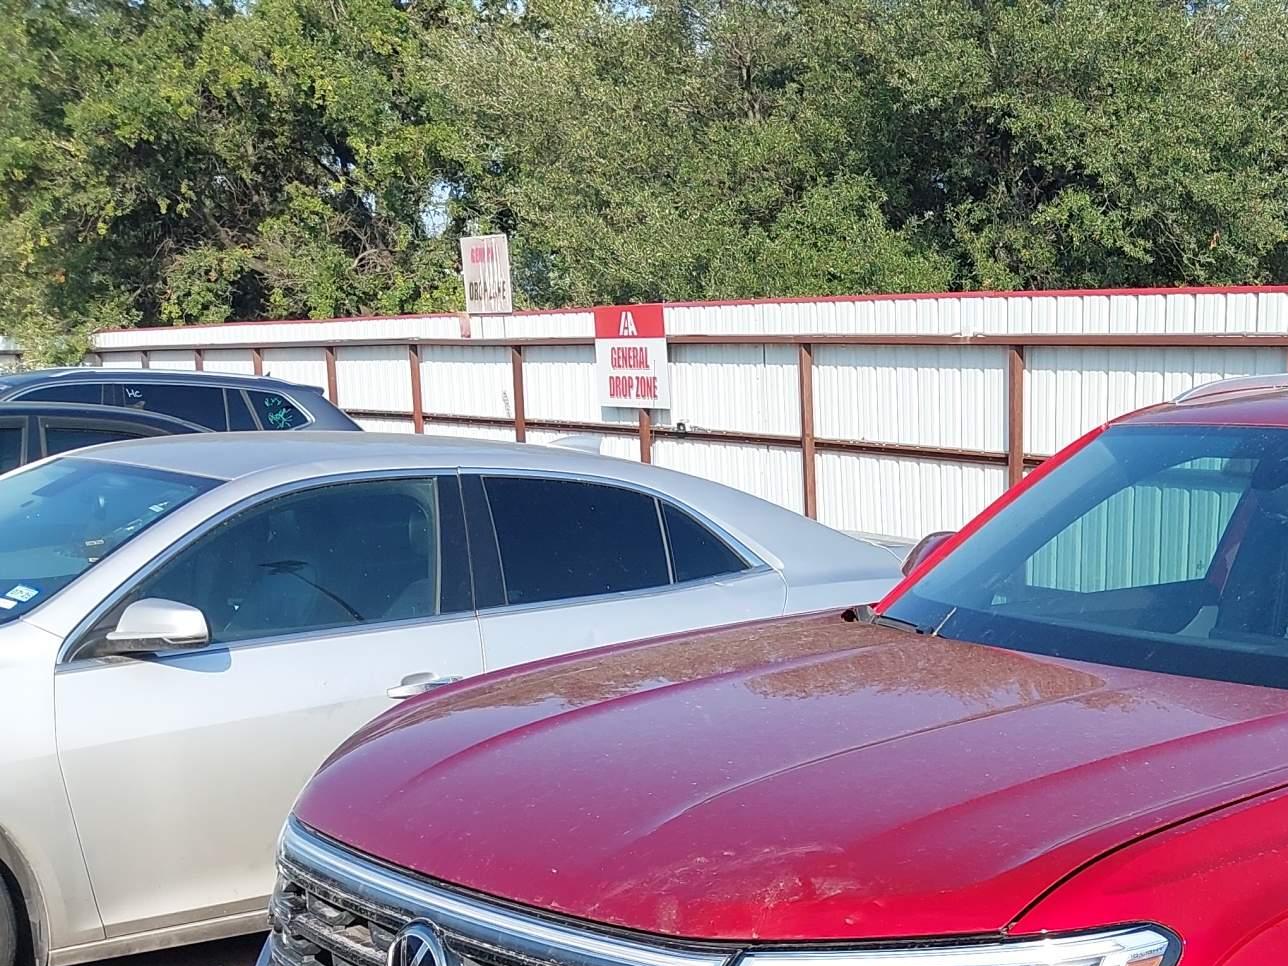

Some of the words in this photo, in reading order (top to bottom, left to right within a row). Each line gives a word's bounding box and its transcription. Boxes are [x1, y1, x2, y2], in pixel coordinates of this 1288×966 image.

[610, 346, 650, 369] GENERAL
[609, 375, 634, 399] DROP
[635, 375, 658, 400] ZONE
